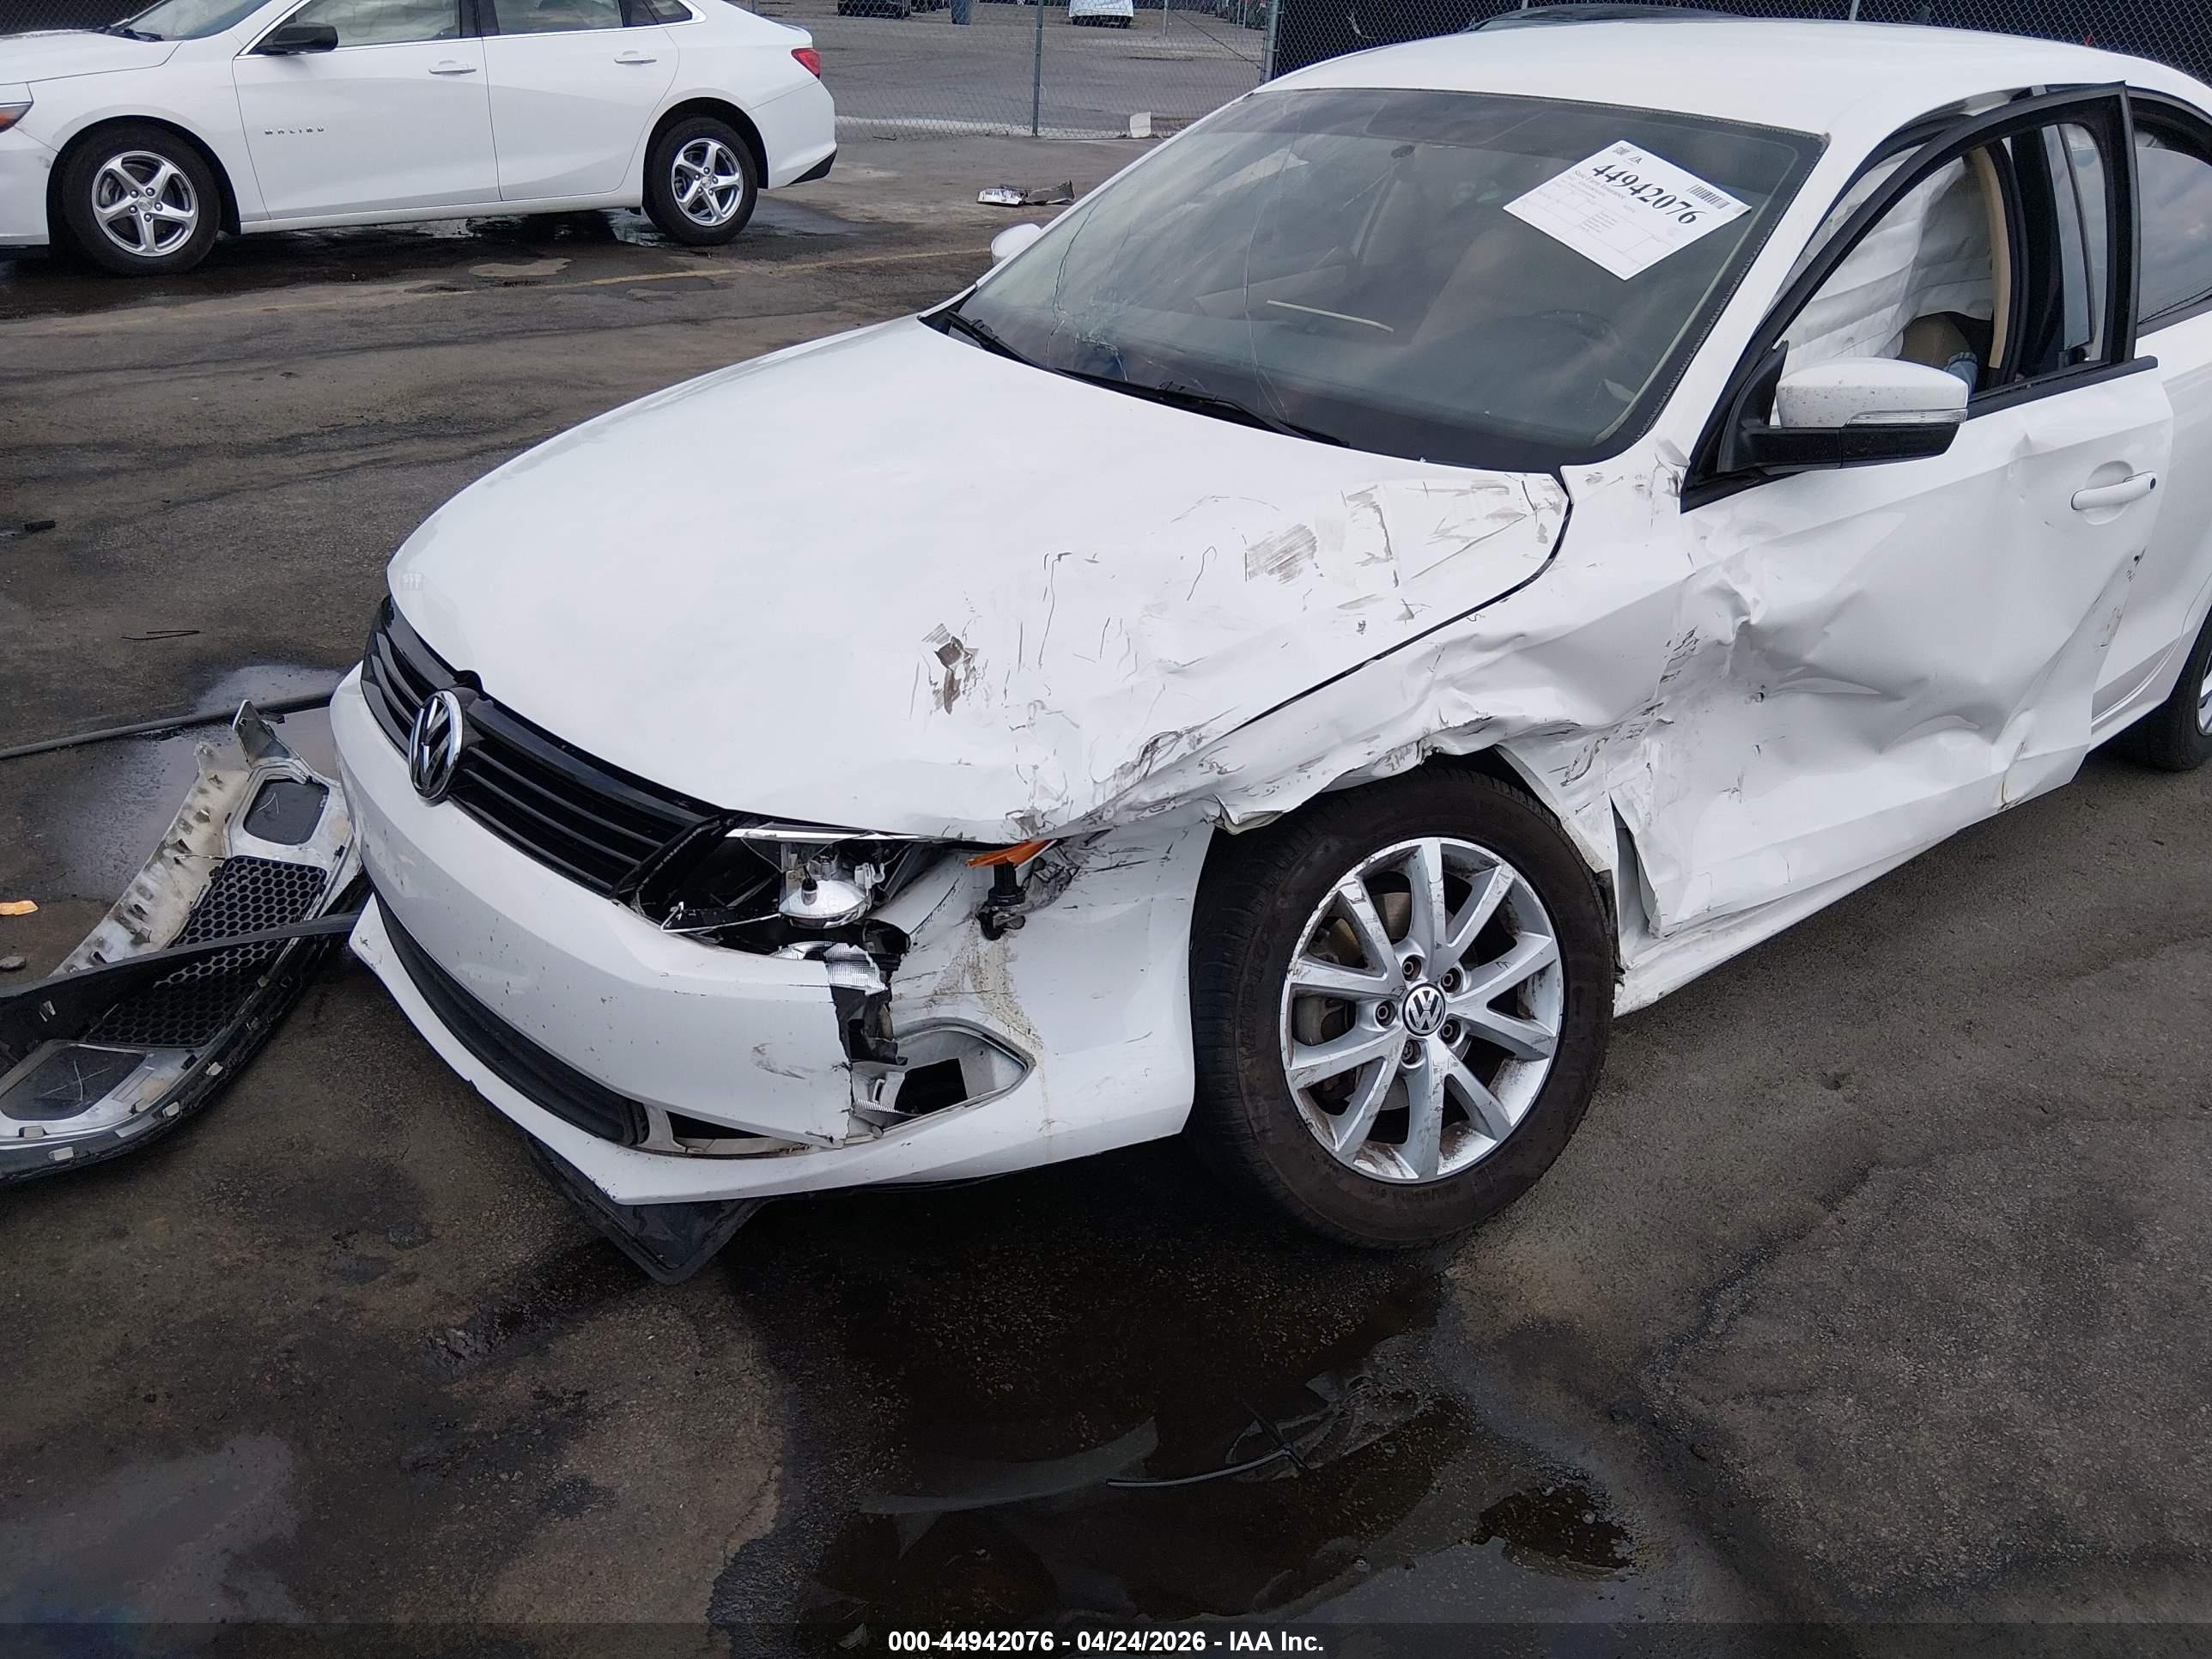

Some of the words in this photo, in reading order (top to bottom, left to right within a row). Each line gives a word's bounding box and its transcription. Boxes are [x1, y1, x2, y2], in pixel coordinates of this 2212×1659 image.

[264, 126, 325, 135] MALIBU
[1592, 164, 1707, 224] 44942076
[1405, 984, 1443, 1034] VW
